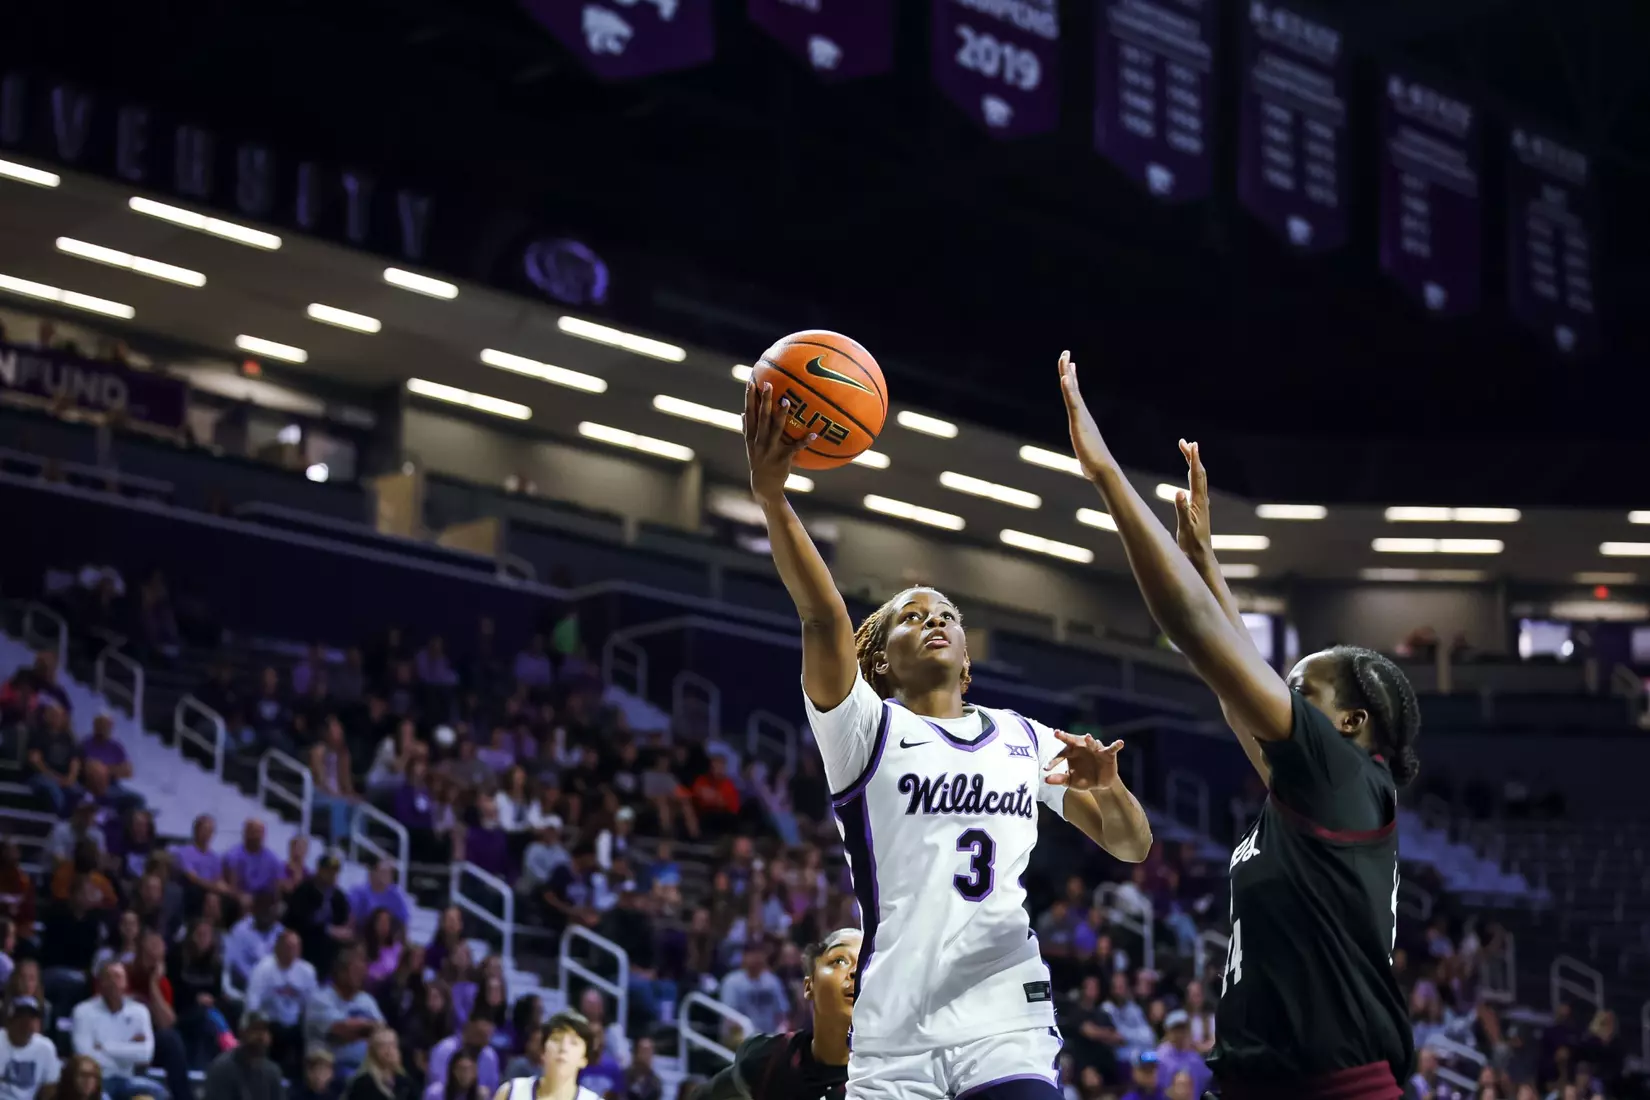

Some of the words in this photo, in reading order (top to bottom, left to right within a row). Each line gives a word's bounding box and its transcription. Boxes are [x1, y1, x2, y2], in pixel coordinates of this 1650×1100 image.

[954, 22, 1041, 91] 2019
[897, 772, 1033, 819] Wildcats
[953, 828, 996, 902] 3
